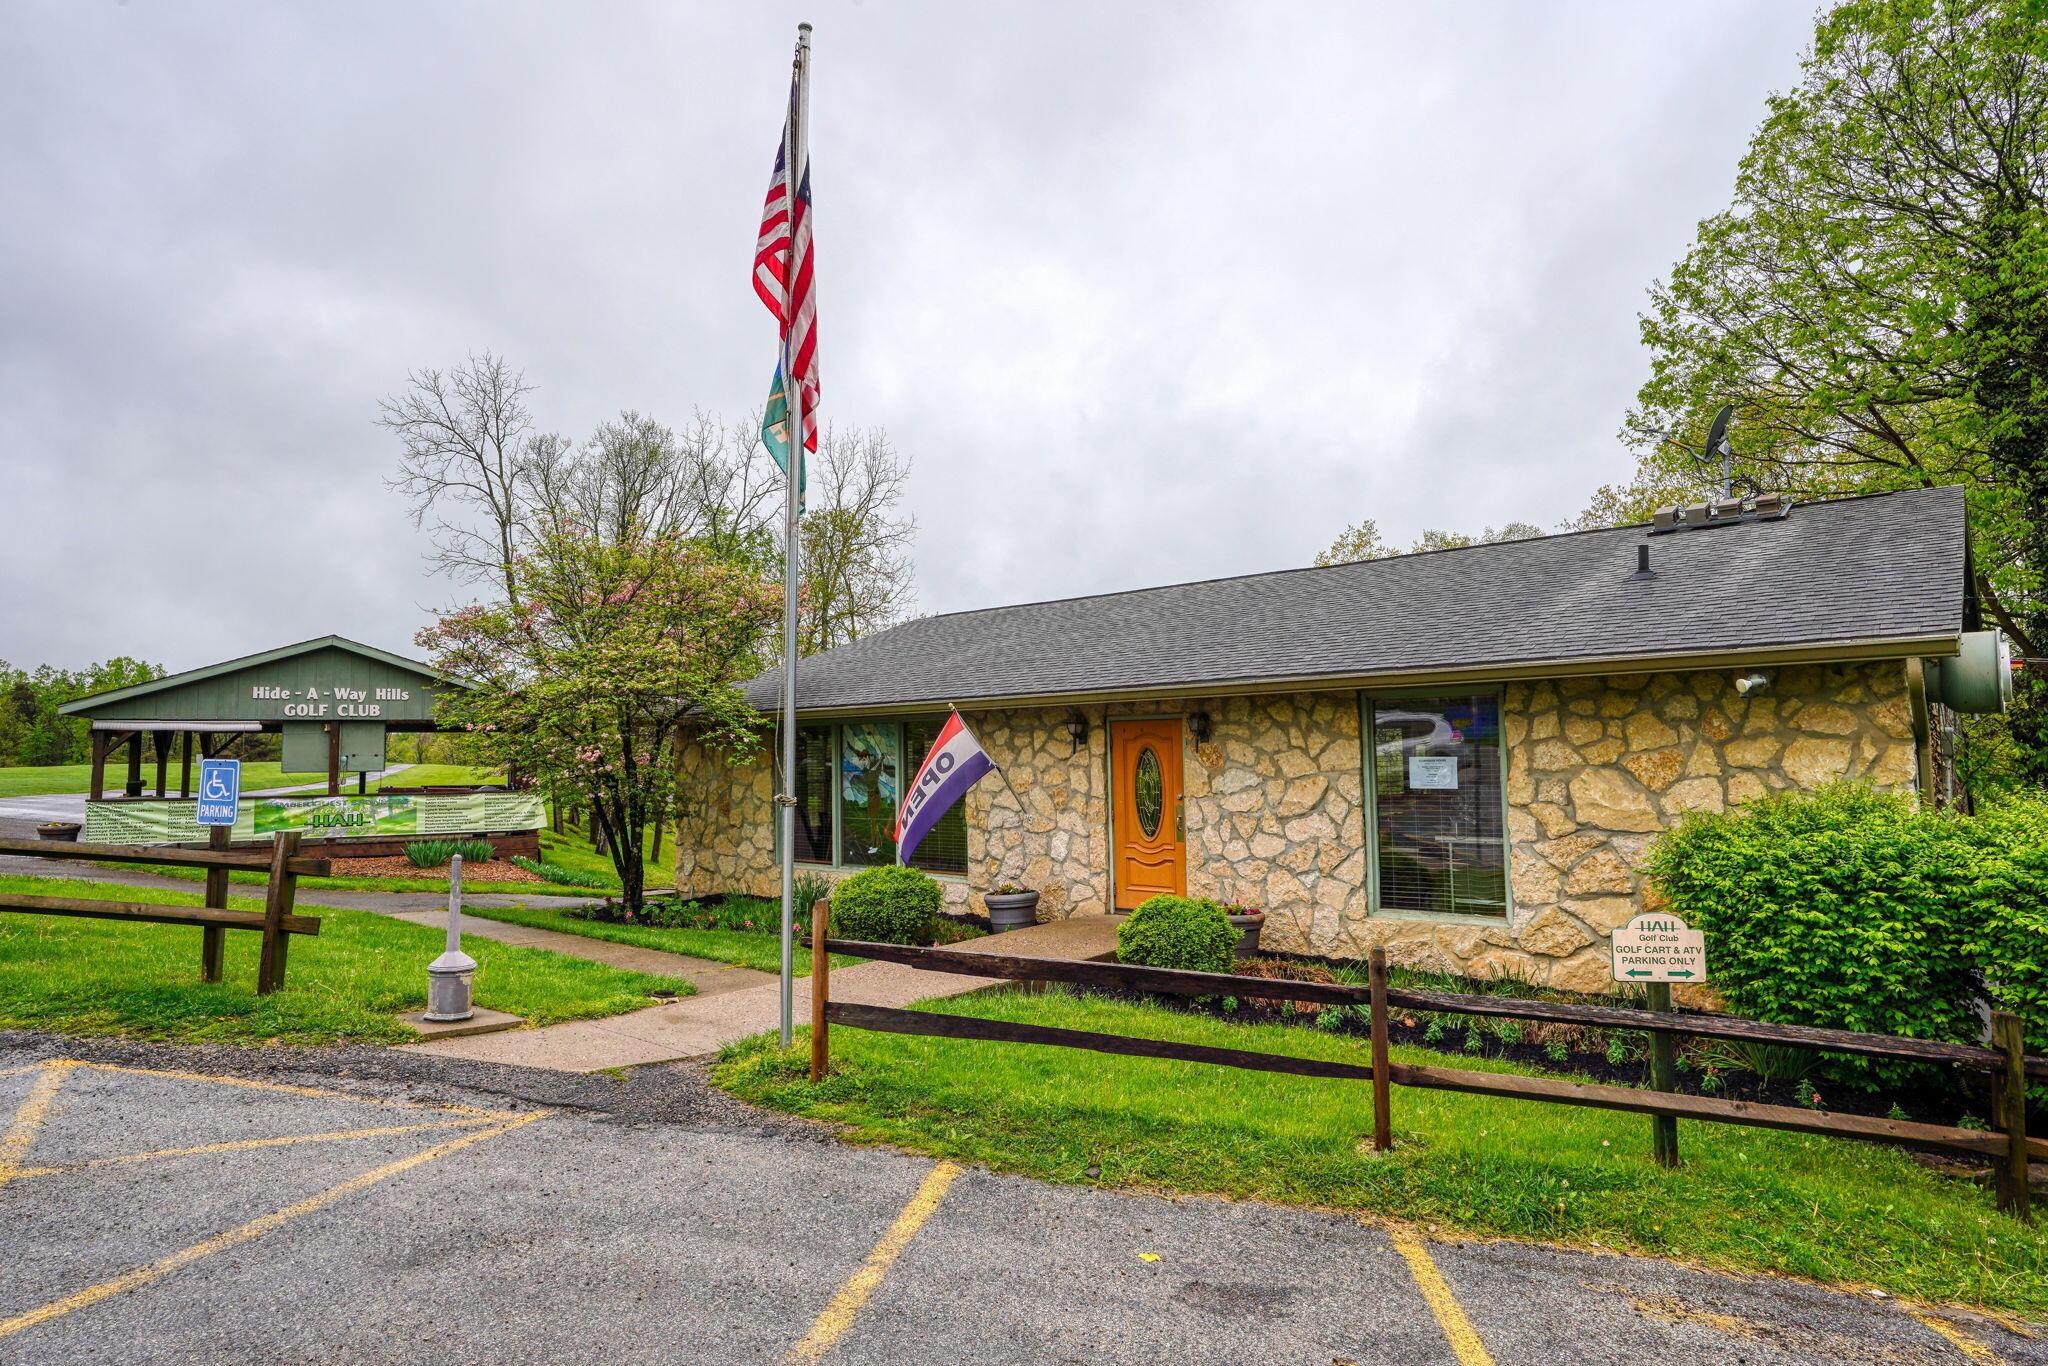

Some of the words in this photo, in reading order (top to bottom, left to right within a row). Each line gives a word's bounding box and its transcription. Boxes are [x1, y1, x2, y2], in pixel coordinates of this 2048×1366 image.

[252, 686, 290, 699] Hide
[306, 688, 319, 700] A
[334, 688, 367, 703] Way
[376, 688, 410, 701] Hills
[284, 704, 329, 717] GOLF
[337, 704, 381, 717] CLUB
[200, 804, 234, 818] PARKING
[313, 813, 363, 828] HAH
[1640, 920, 1675, 932] HAH
[1639, 934, 1657, 942] Golf
[1660, 934, 1679, 942] Club
[1616, 946, 1642, 954] GOLF
[1644, 946, 1671, 954] CART
[1674, 946, 1680, 954] &
[1683, 947, 1702, 955] ATV
[1622, 956, 1666, 965] PARKING
